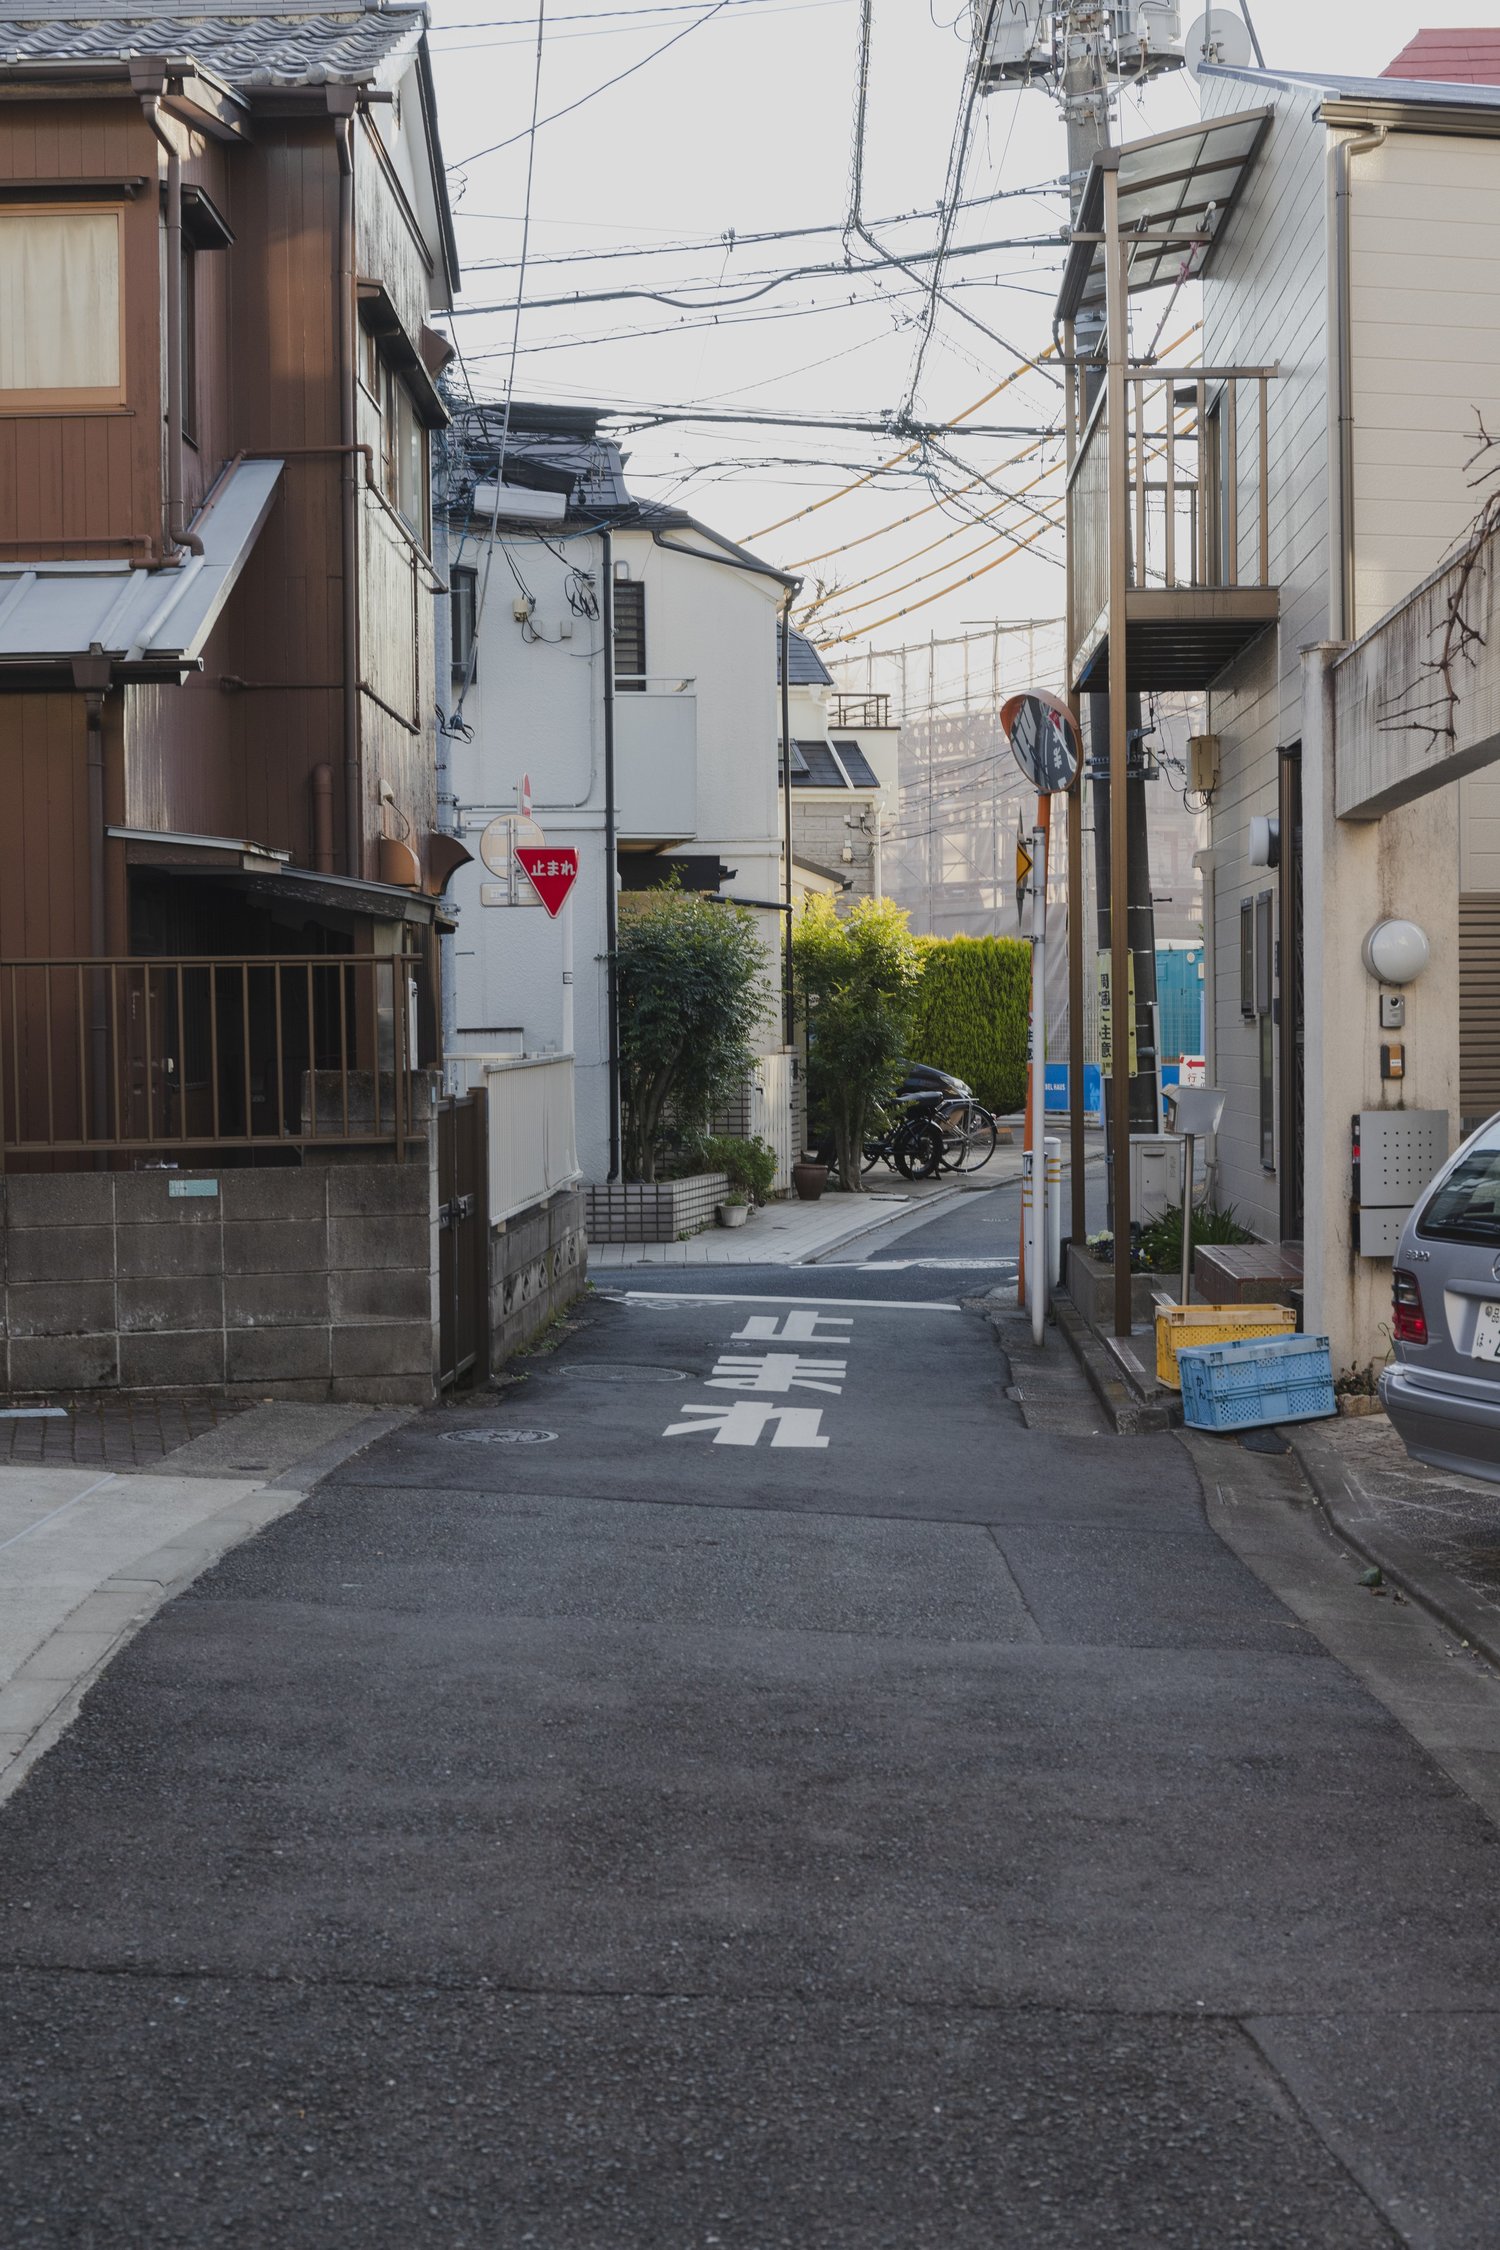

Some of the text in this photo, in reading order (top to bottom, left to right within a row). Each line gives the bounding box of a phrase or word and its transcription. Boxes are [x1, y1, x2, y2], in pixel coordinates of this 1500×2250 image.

[531, 860, 576, 877] 止まれ
[662, 1310, 854, 1448] 止まれ
